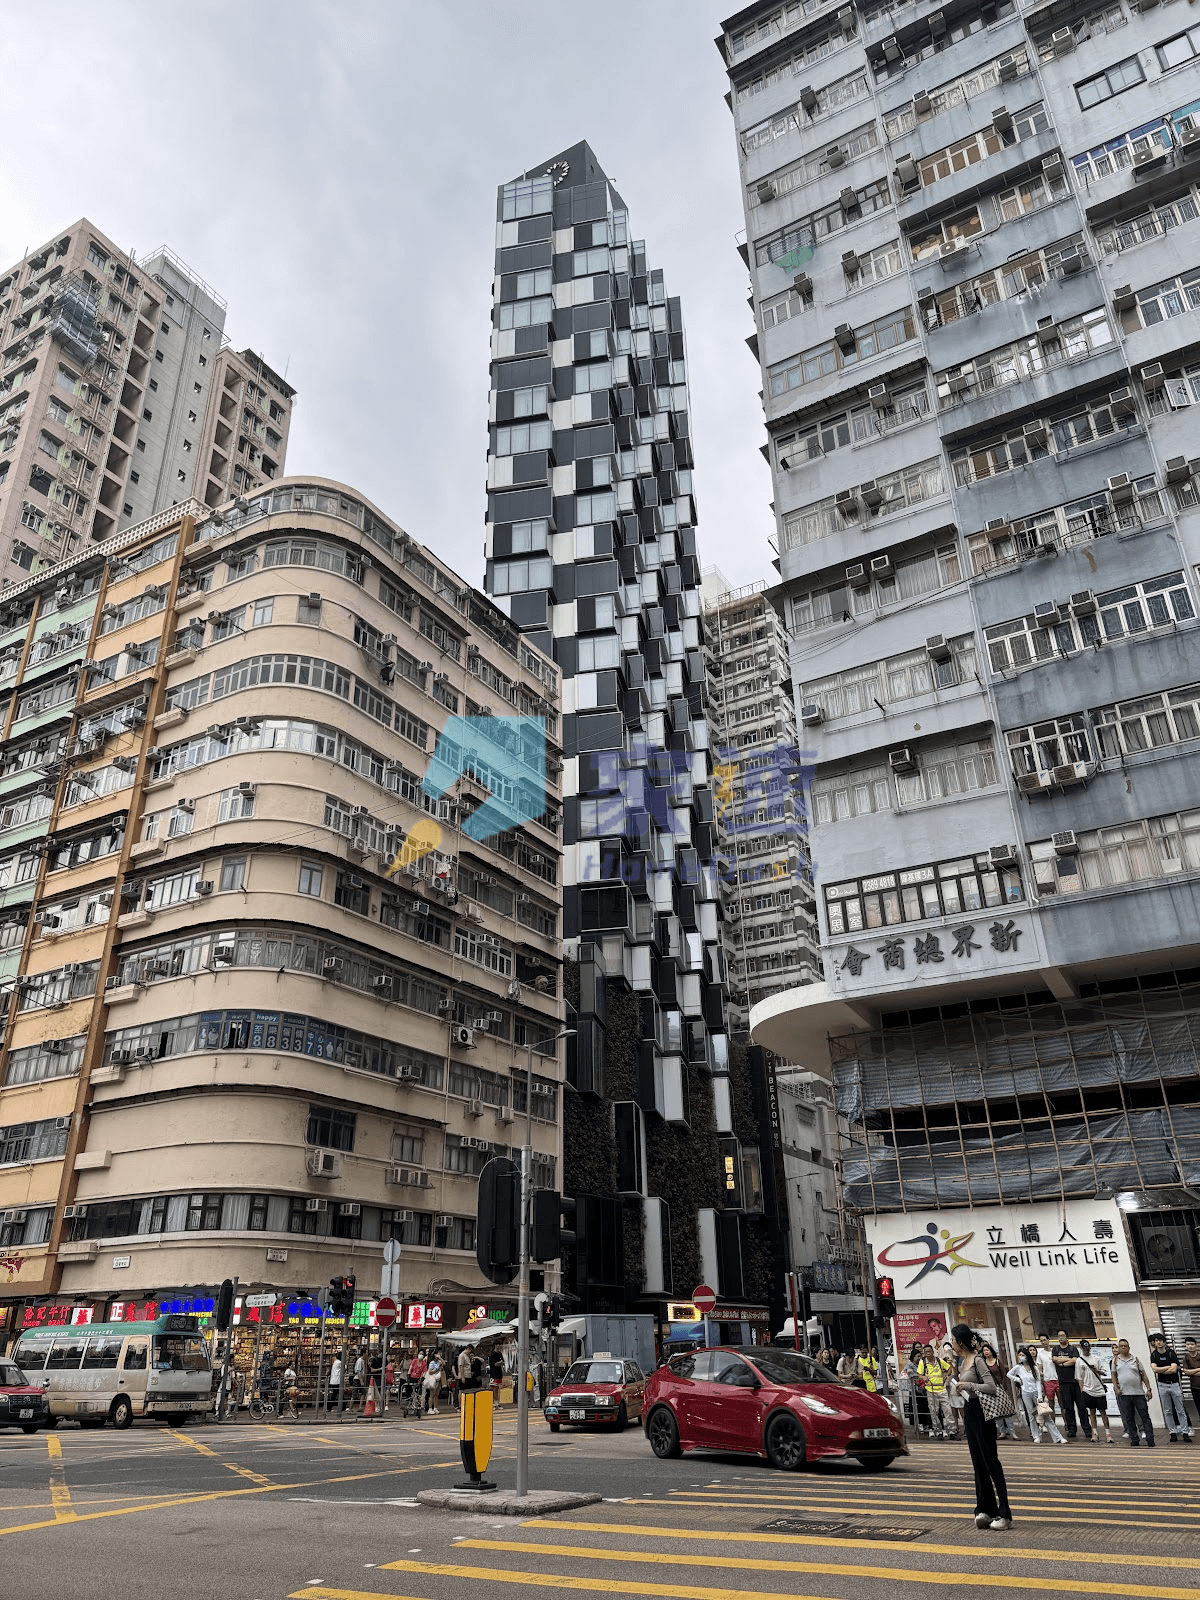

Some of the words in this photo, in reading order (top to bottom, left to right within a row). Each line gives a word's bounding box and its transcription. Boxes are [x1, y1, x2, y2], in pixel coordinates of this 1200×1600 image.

[863, 879, 879, 891] 2369
[879, 876, 895, 888] 4818
[256, 1014, 278, 1022] happy
[767, 1076, 778, 1128] BEACON
[986, 1219, 1114, 1246] 立橋人壽
[989, 1249, 1031, 1269] Well
[1038, 1248, 1078, 1266] Link
[1084, 1245, 1120, 1265] Life
